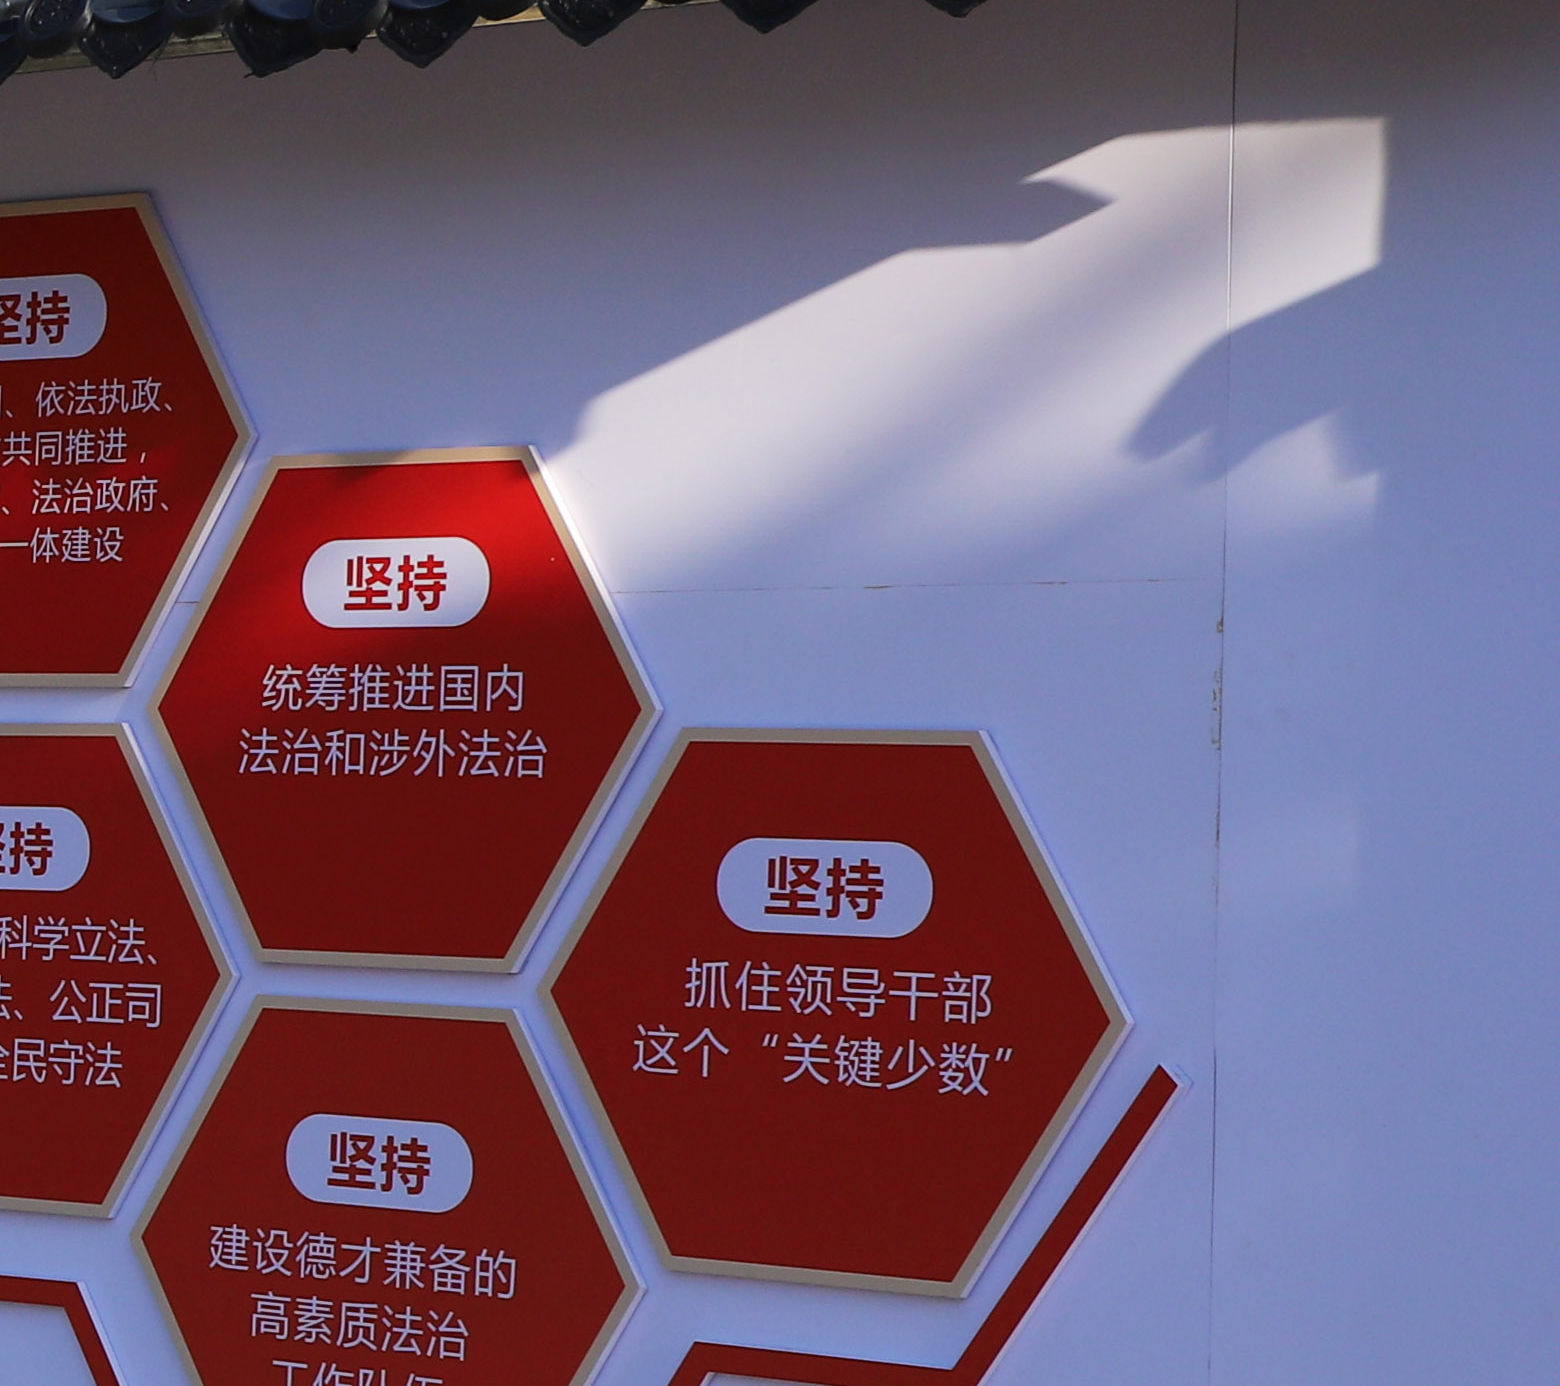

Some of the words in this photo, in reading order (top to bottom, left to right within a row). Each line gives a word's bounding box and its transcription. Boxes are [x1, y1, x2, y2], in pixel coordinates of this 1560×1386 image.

[343, 554, 448, 612] 坚持
[261, 662, 525, 714] 统筹推进国内
[237, 727, 548, 779] 法治和涉外法治
[764, 855, 885, 921] 坚持
[683, 957, 993, 1025] 抓住领导干部
[326, 1131, 432, 1196] 坚持
[208, 1223, 517, 1300] 建设德才兼备的
[249, 1291, 469, 1362] 高素质法治
